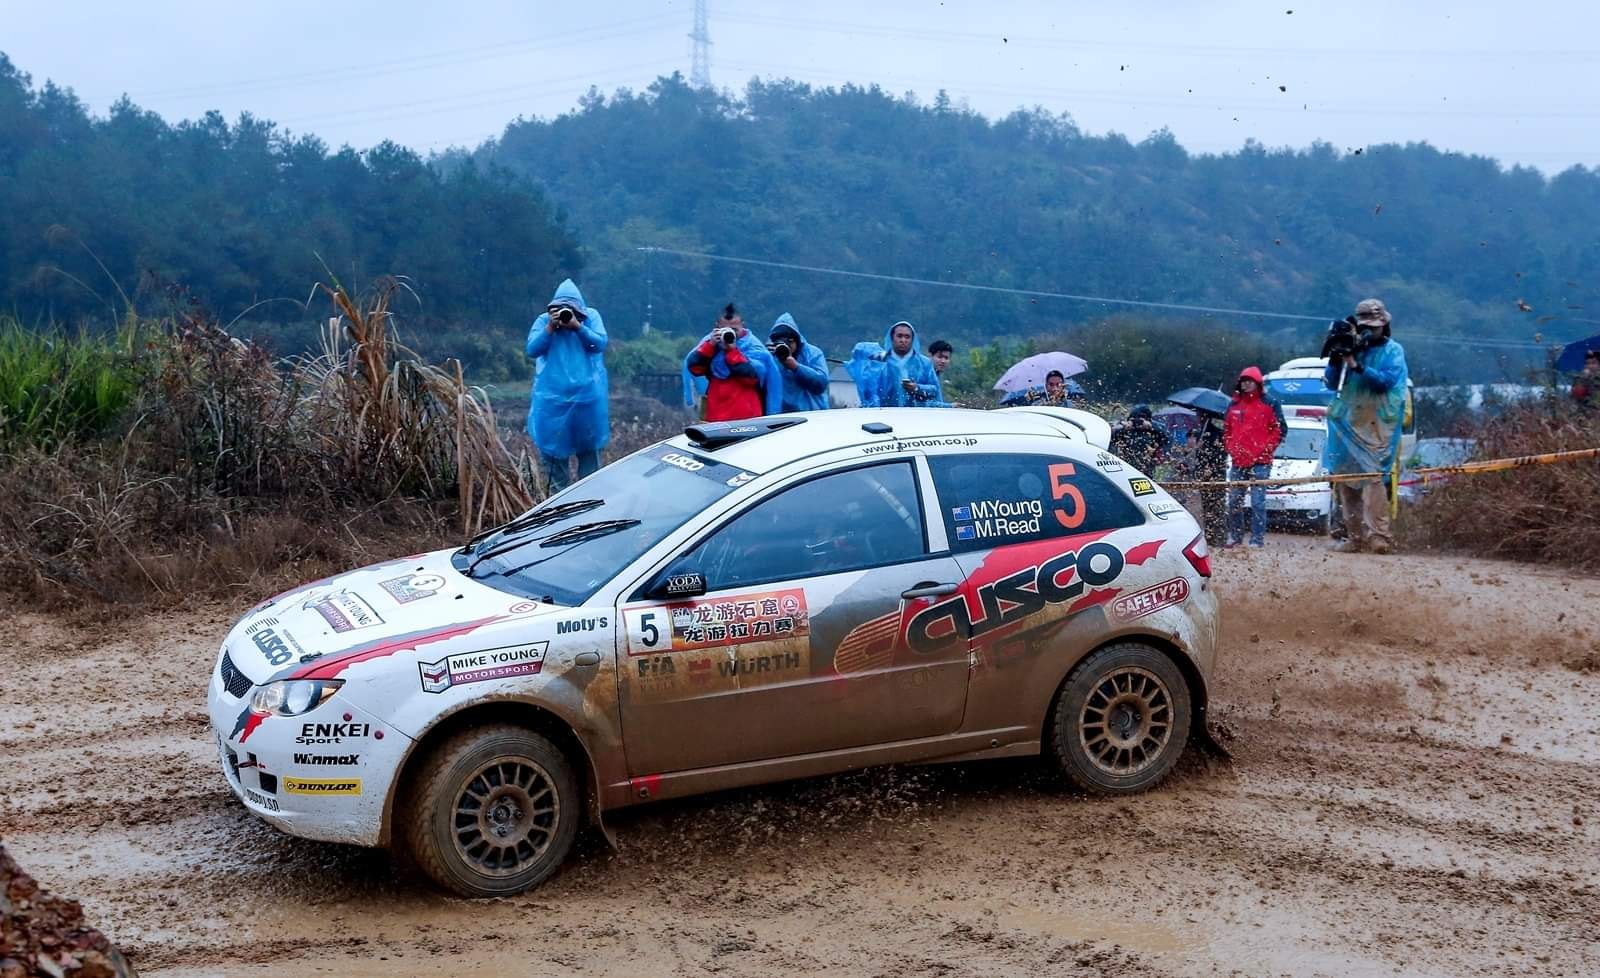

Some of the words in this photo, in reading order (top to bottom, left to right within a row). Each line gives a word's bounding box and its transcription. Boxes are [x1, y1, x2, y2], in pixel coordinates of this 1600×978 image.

[862, 437, 978, 455] www.proton.co.jp
[661, 453, 705, 472] CUSCO
[1047, 462, 1087, 529] 5
[1133, 481, 1152, 492] OMP
[970, 499, 1043, 520] M.Young
[974, 517, 1041, 538] M.Read
[666, 575, 702, 588] YODA
[905, 540, 1125, 655] CUSCO
[693, 598, 780, 625] 龙游石窟
[557, 616, 608, 634] Moty's
[640, 612, 659, 647] 5
[684, 616, 793, 642] 龙游拉力赛
[252, 628, 293, 666] CUSCO
[452, 656, 487, 671] MIKE
[491, 648, 540, 664] YOUNG
[455, 664, 537, 682] MOTORSPORT
[301, 723, 370, 737] ENKEI
[295, 736, 342, 746] Sport
[294, 753, 360, 766] Winmax
[296, 783, 358, 791] DUNLOP
